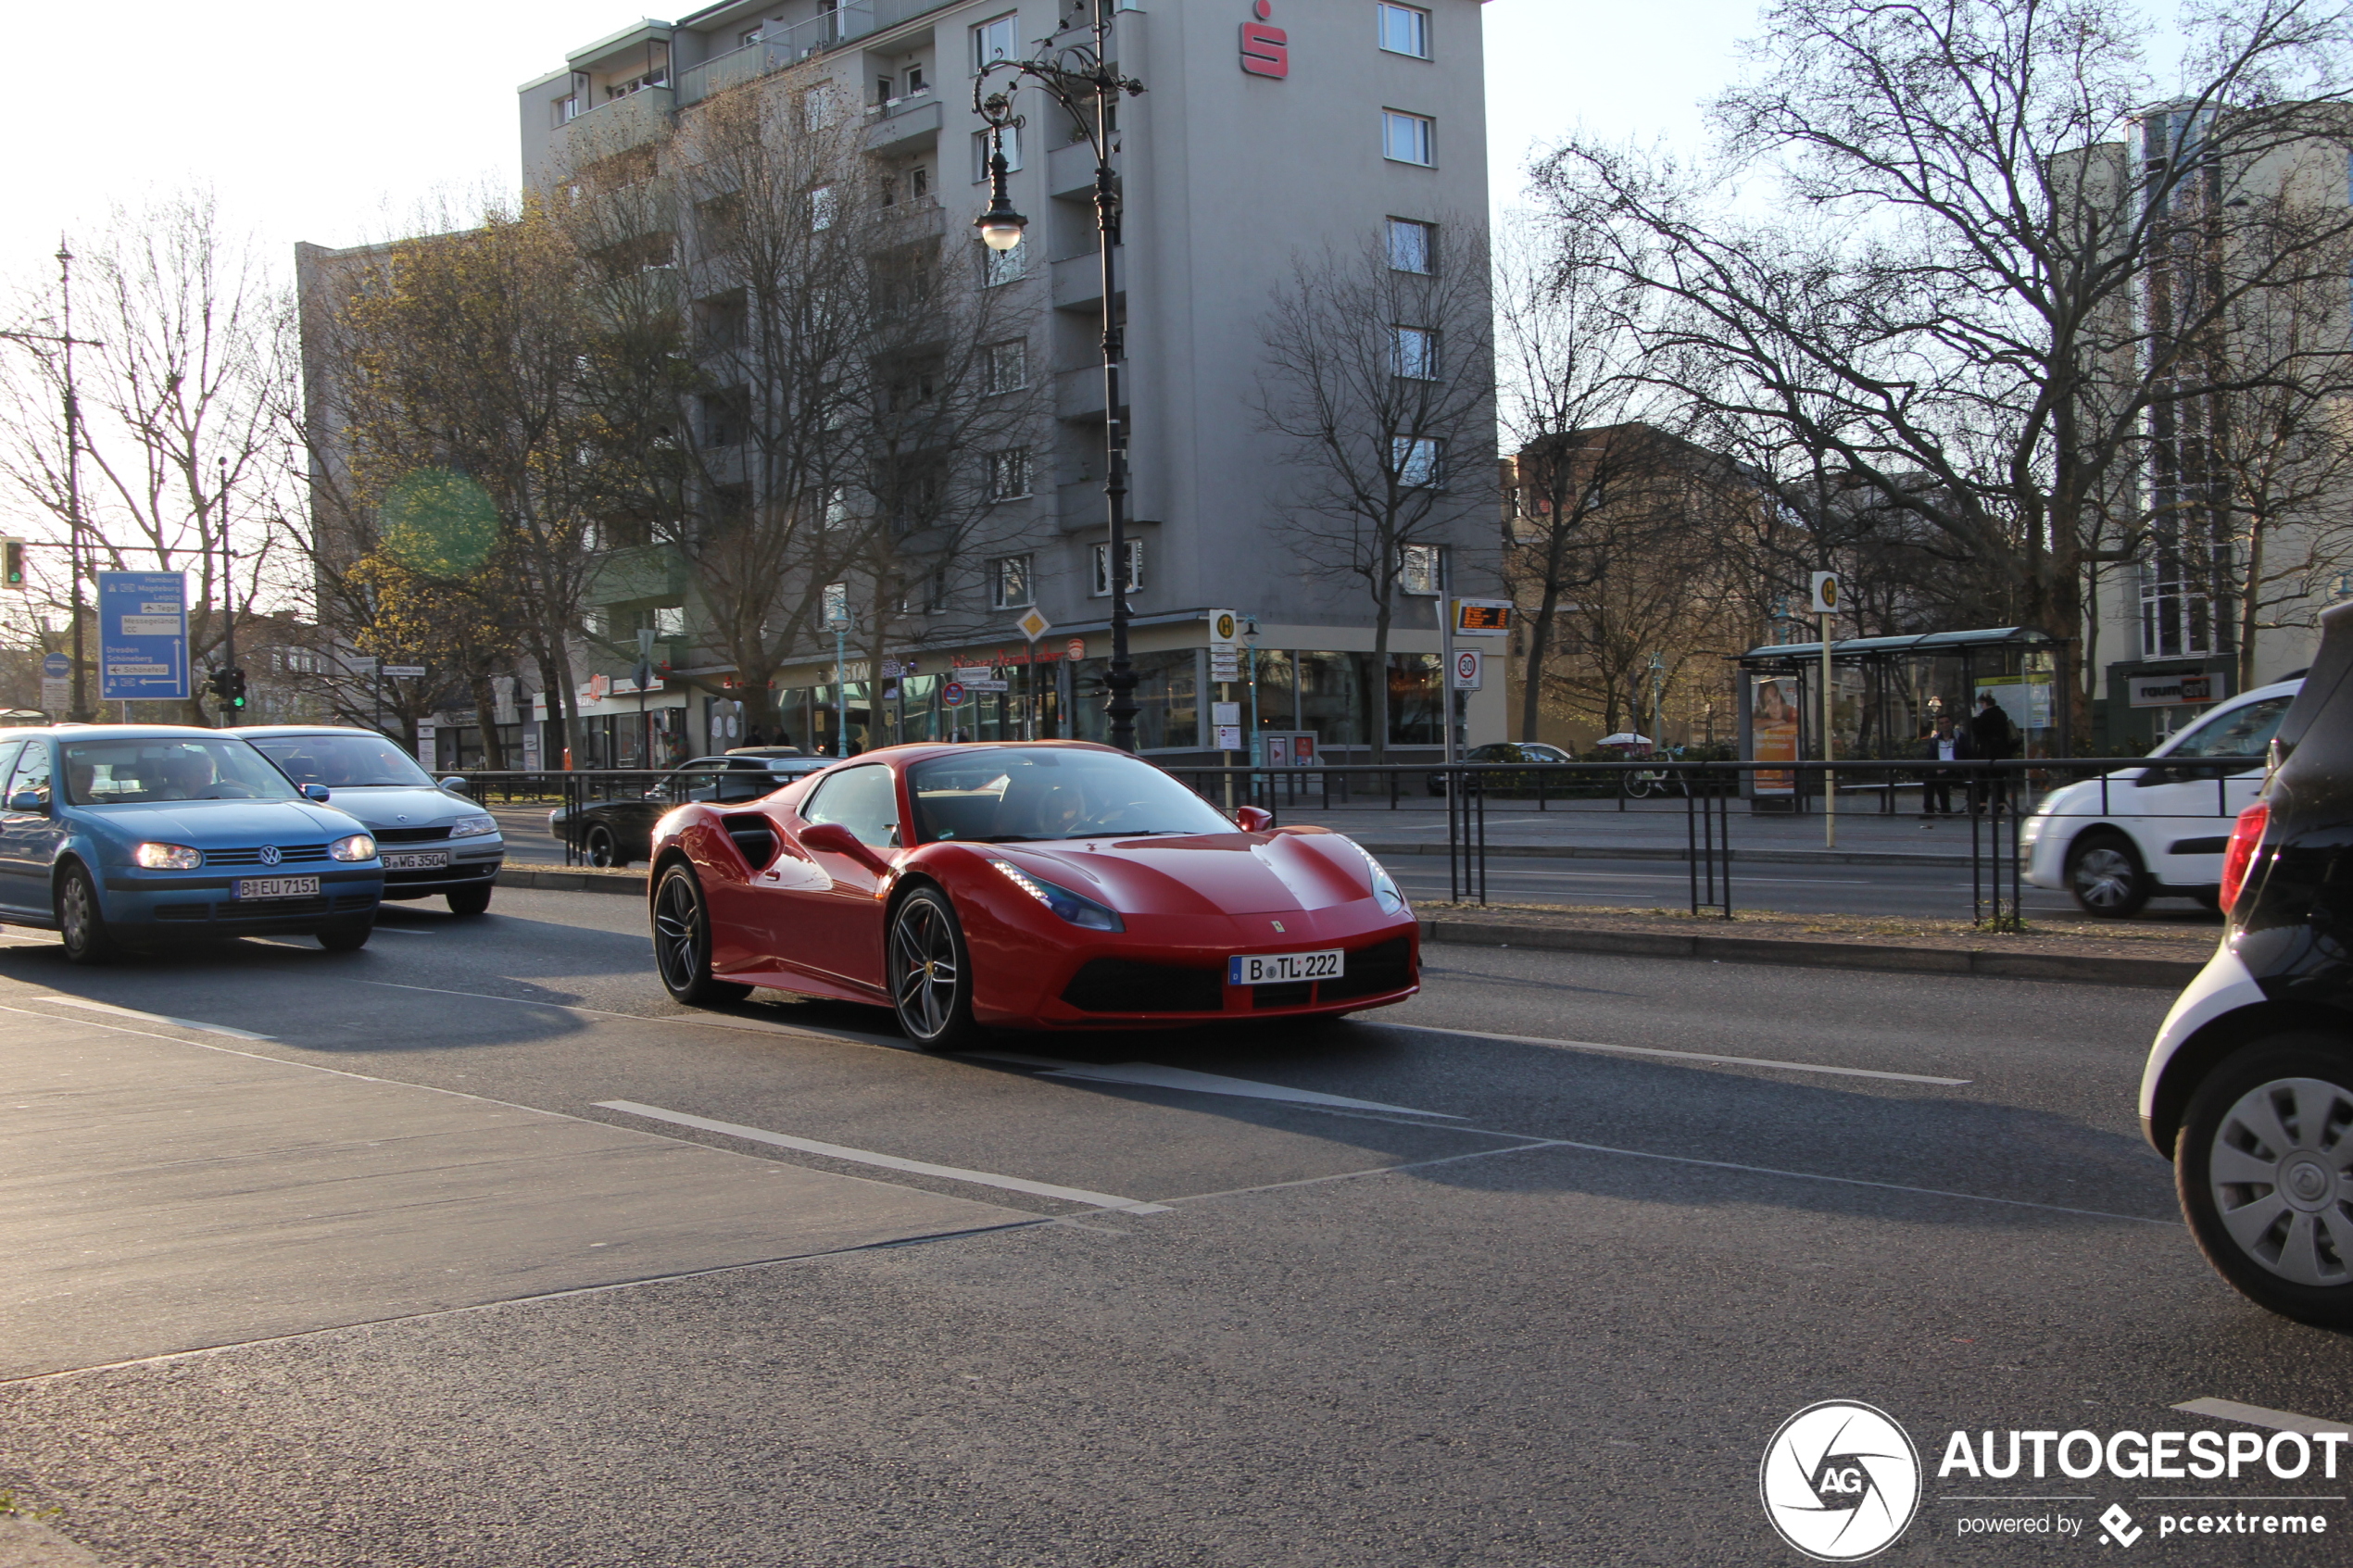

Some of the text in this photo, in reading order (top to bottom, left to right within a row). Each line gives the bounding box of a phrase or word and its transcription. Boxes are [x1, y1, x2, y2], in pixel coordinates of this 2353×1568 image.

[145, 576, 181, 584] Hamburg
[107, 646, 139, 654] Dresden
[997, 644, 1064, 666] Feinbcker
[107, 655, 153, 663] Schöneberg
[1461, 659, 1473, 671] 30
[399, 855, 415, 868] WG
[418, 854, 447, 866] 3504
[242, 878, 319, 897] B EU 7151
[1251, 954, 1337, 980] B TL 222
